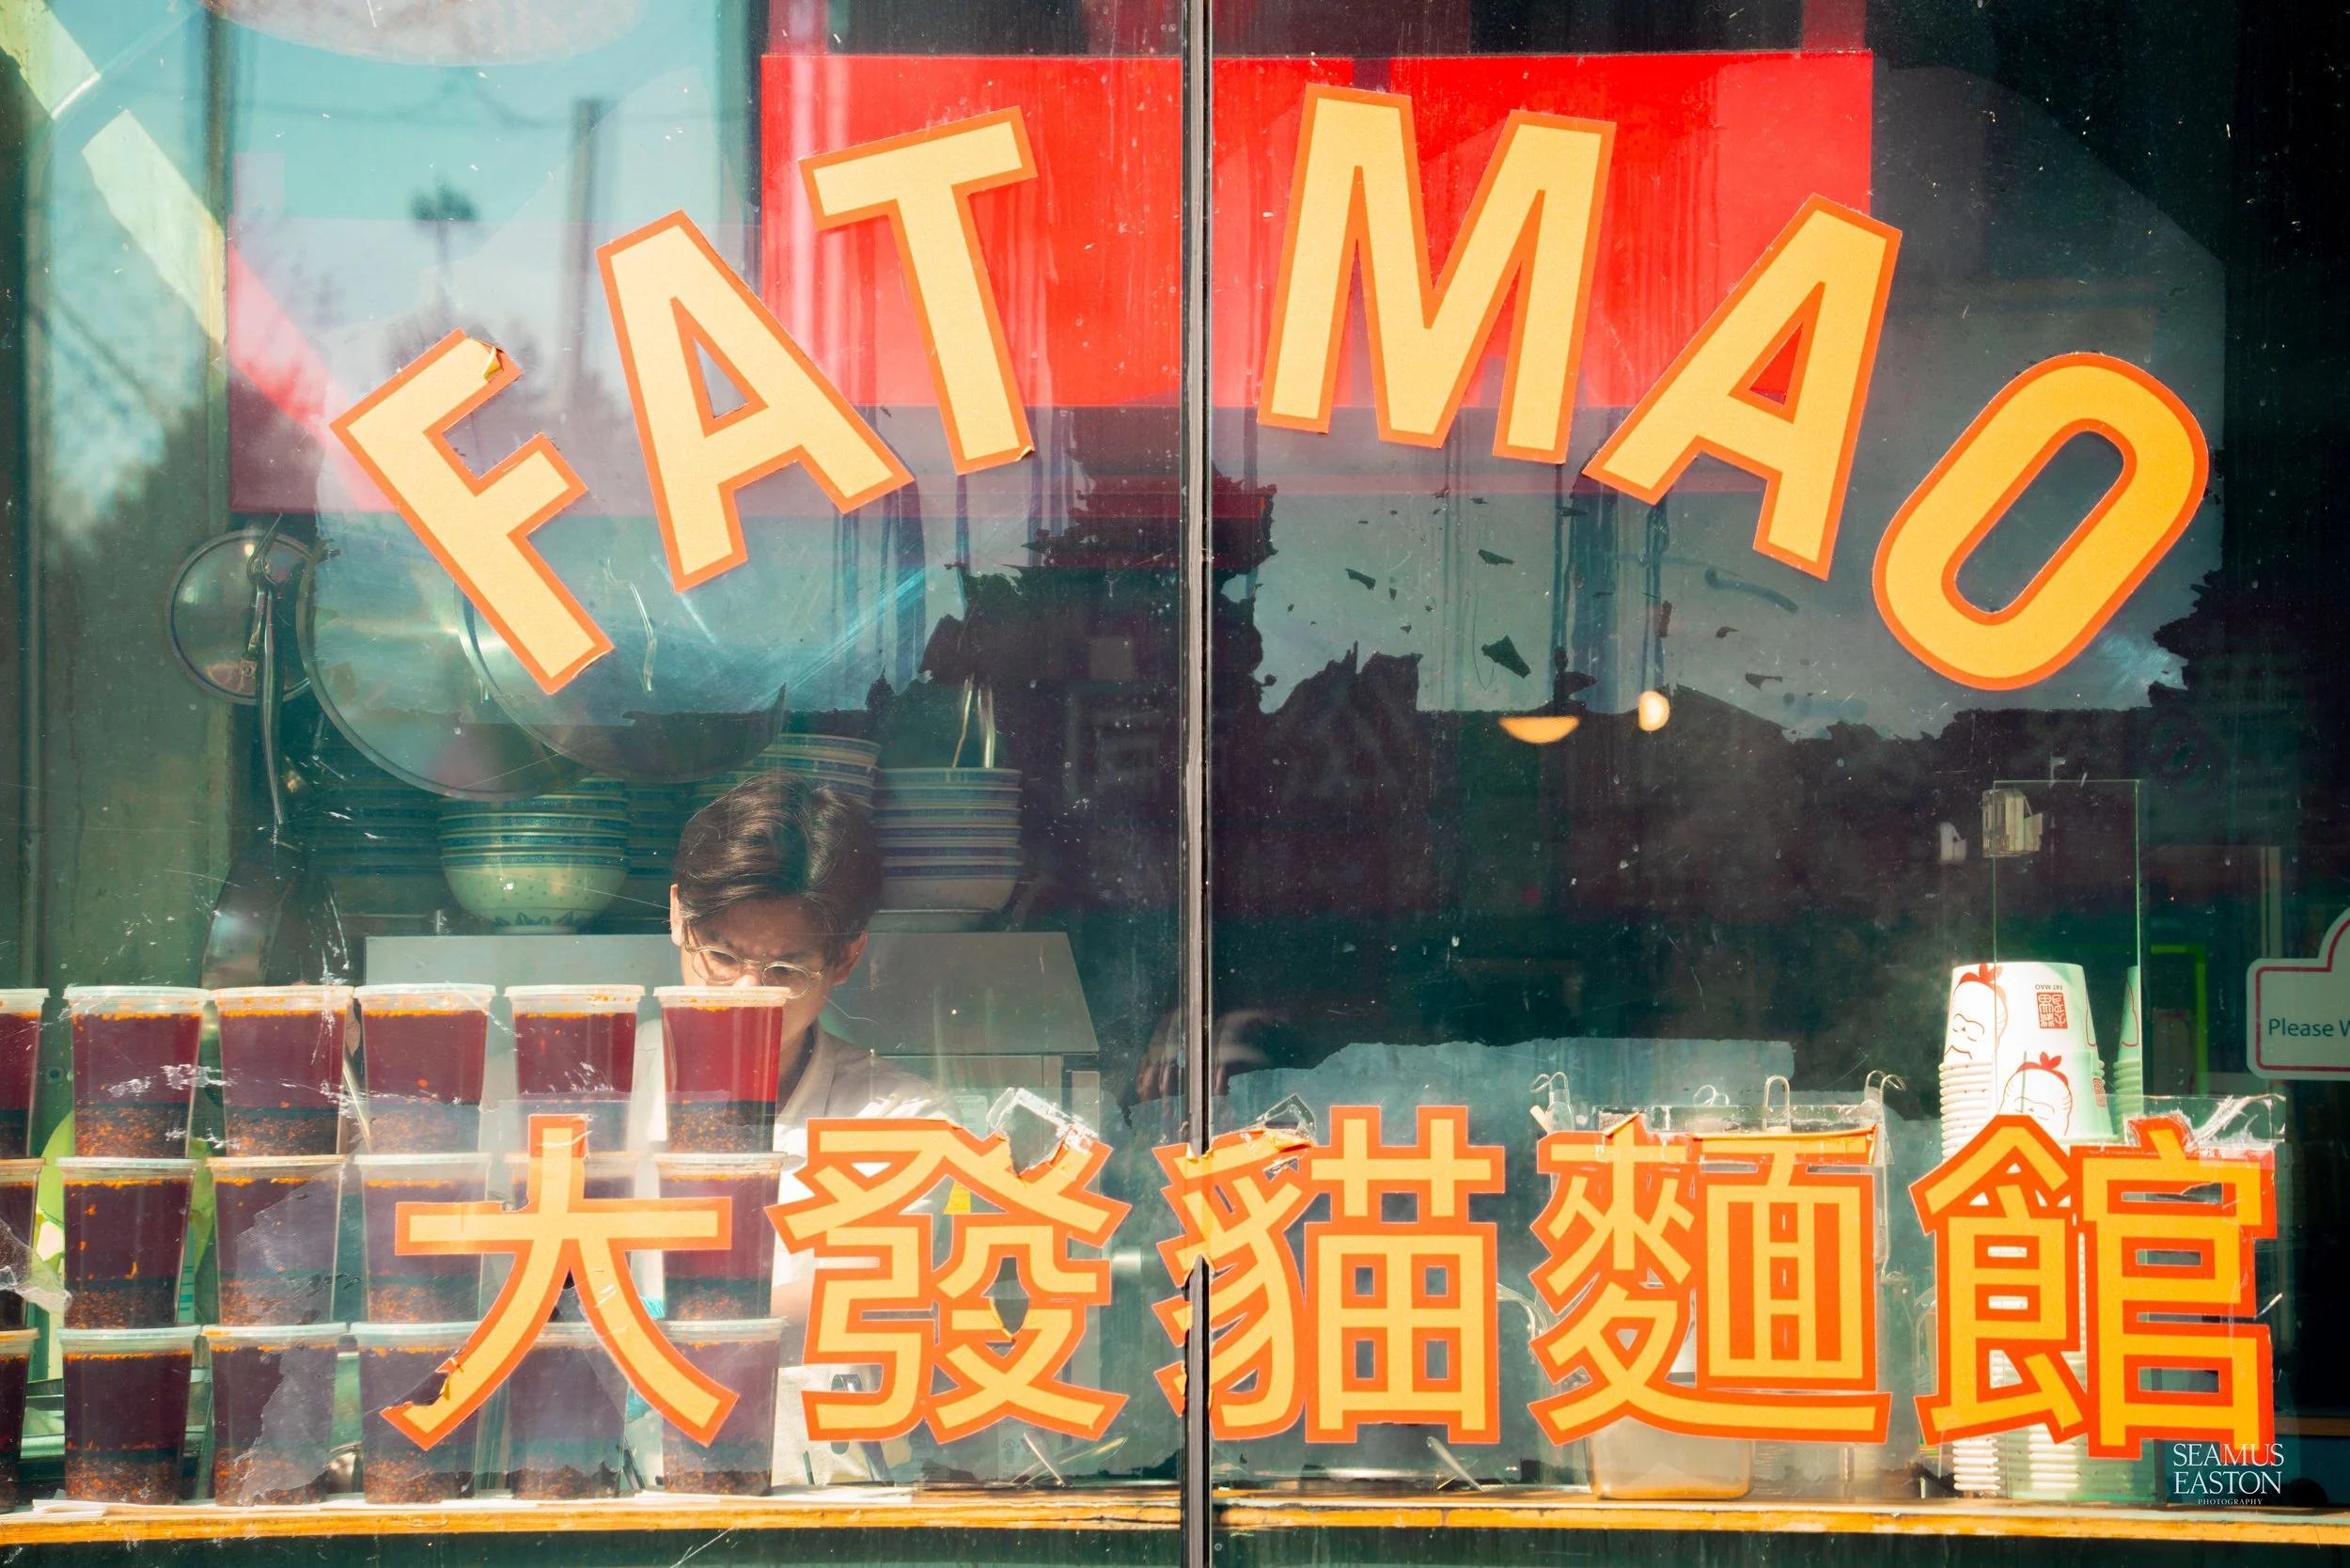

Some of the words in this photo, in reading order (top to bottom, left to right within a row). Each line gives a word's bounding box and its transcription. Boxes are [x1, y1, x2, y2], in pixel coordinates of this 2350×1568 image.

[330, 105, 1038, 695] FAT
[1257, 82, 2209, 691] MAO
[2268, 1017, 2334, 1037] Please
[380, 1105, 2277, 1466] 大發貓麵館
